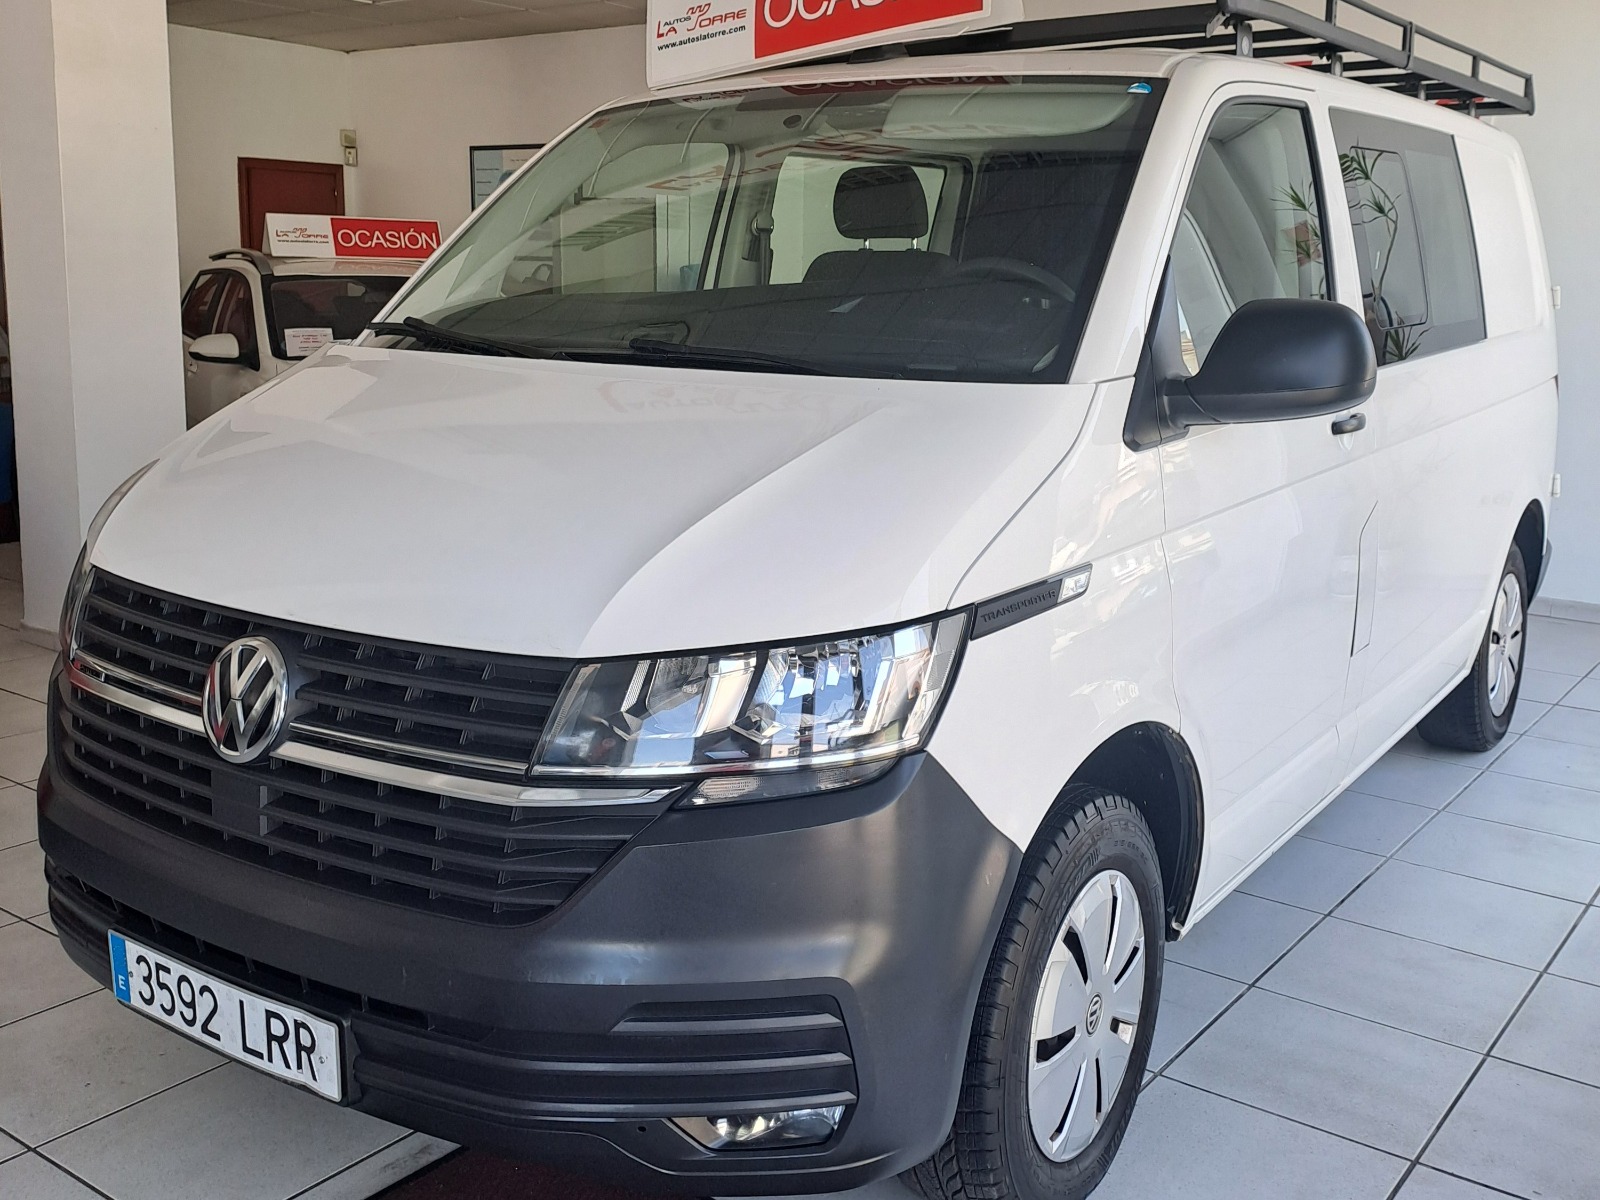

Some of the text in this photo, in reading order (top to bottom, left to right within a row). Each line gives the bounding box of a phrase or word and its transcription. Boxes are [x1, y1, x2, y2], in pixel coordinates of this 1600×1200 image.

[657, 20, 678, 39] LA
[663, 15, 692, 27] AUTOS
[657, 24, 746, 52] www.autoslatorre.com
[337, 228, 438, 250] OCASIÓN
[980, 589, 1057, 623] TRANSPORTER
[118, 974, 127, 991] E
[136, 954, 319, 1083] 3592 LRR
